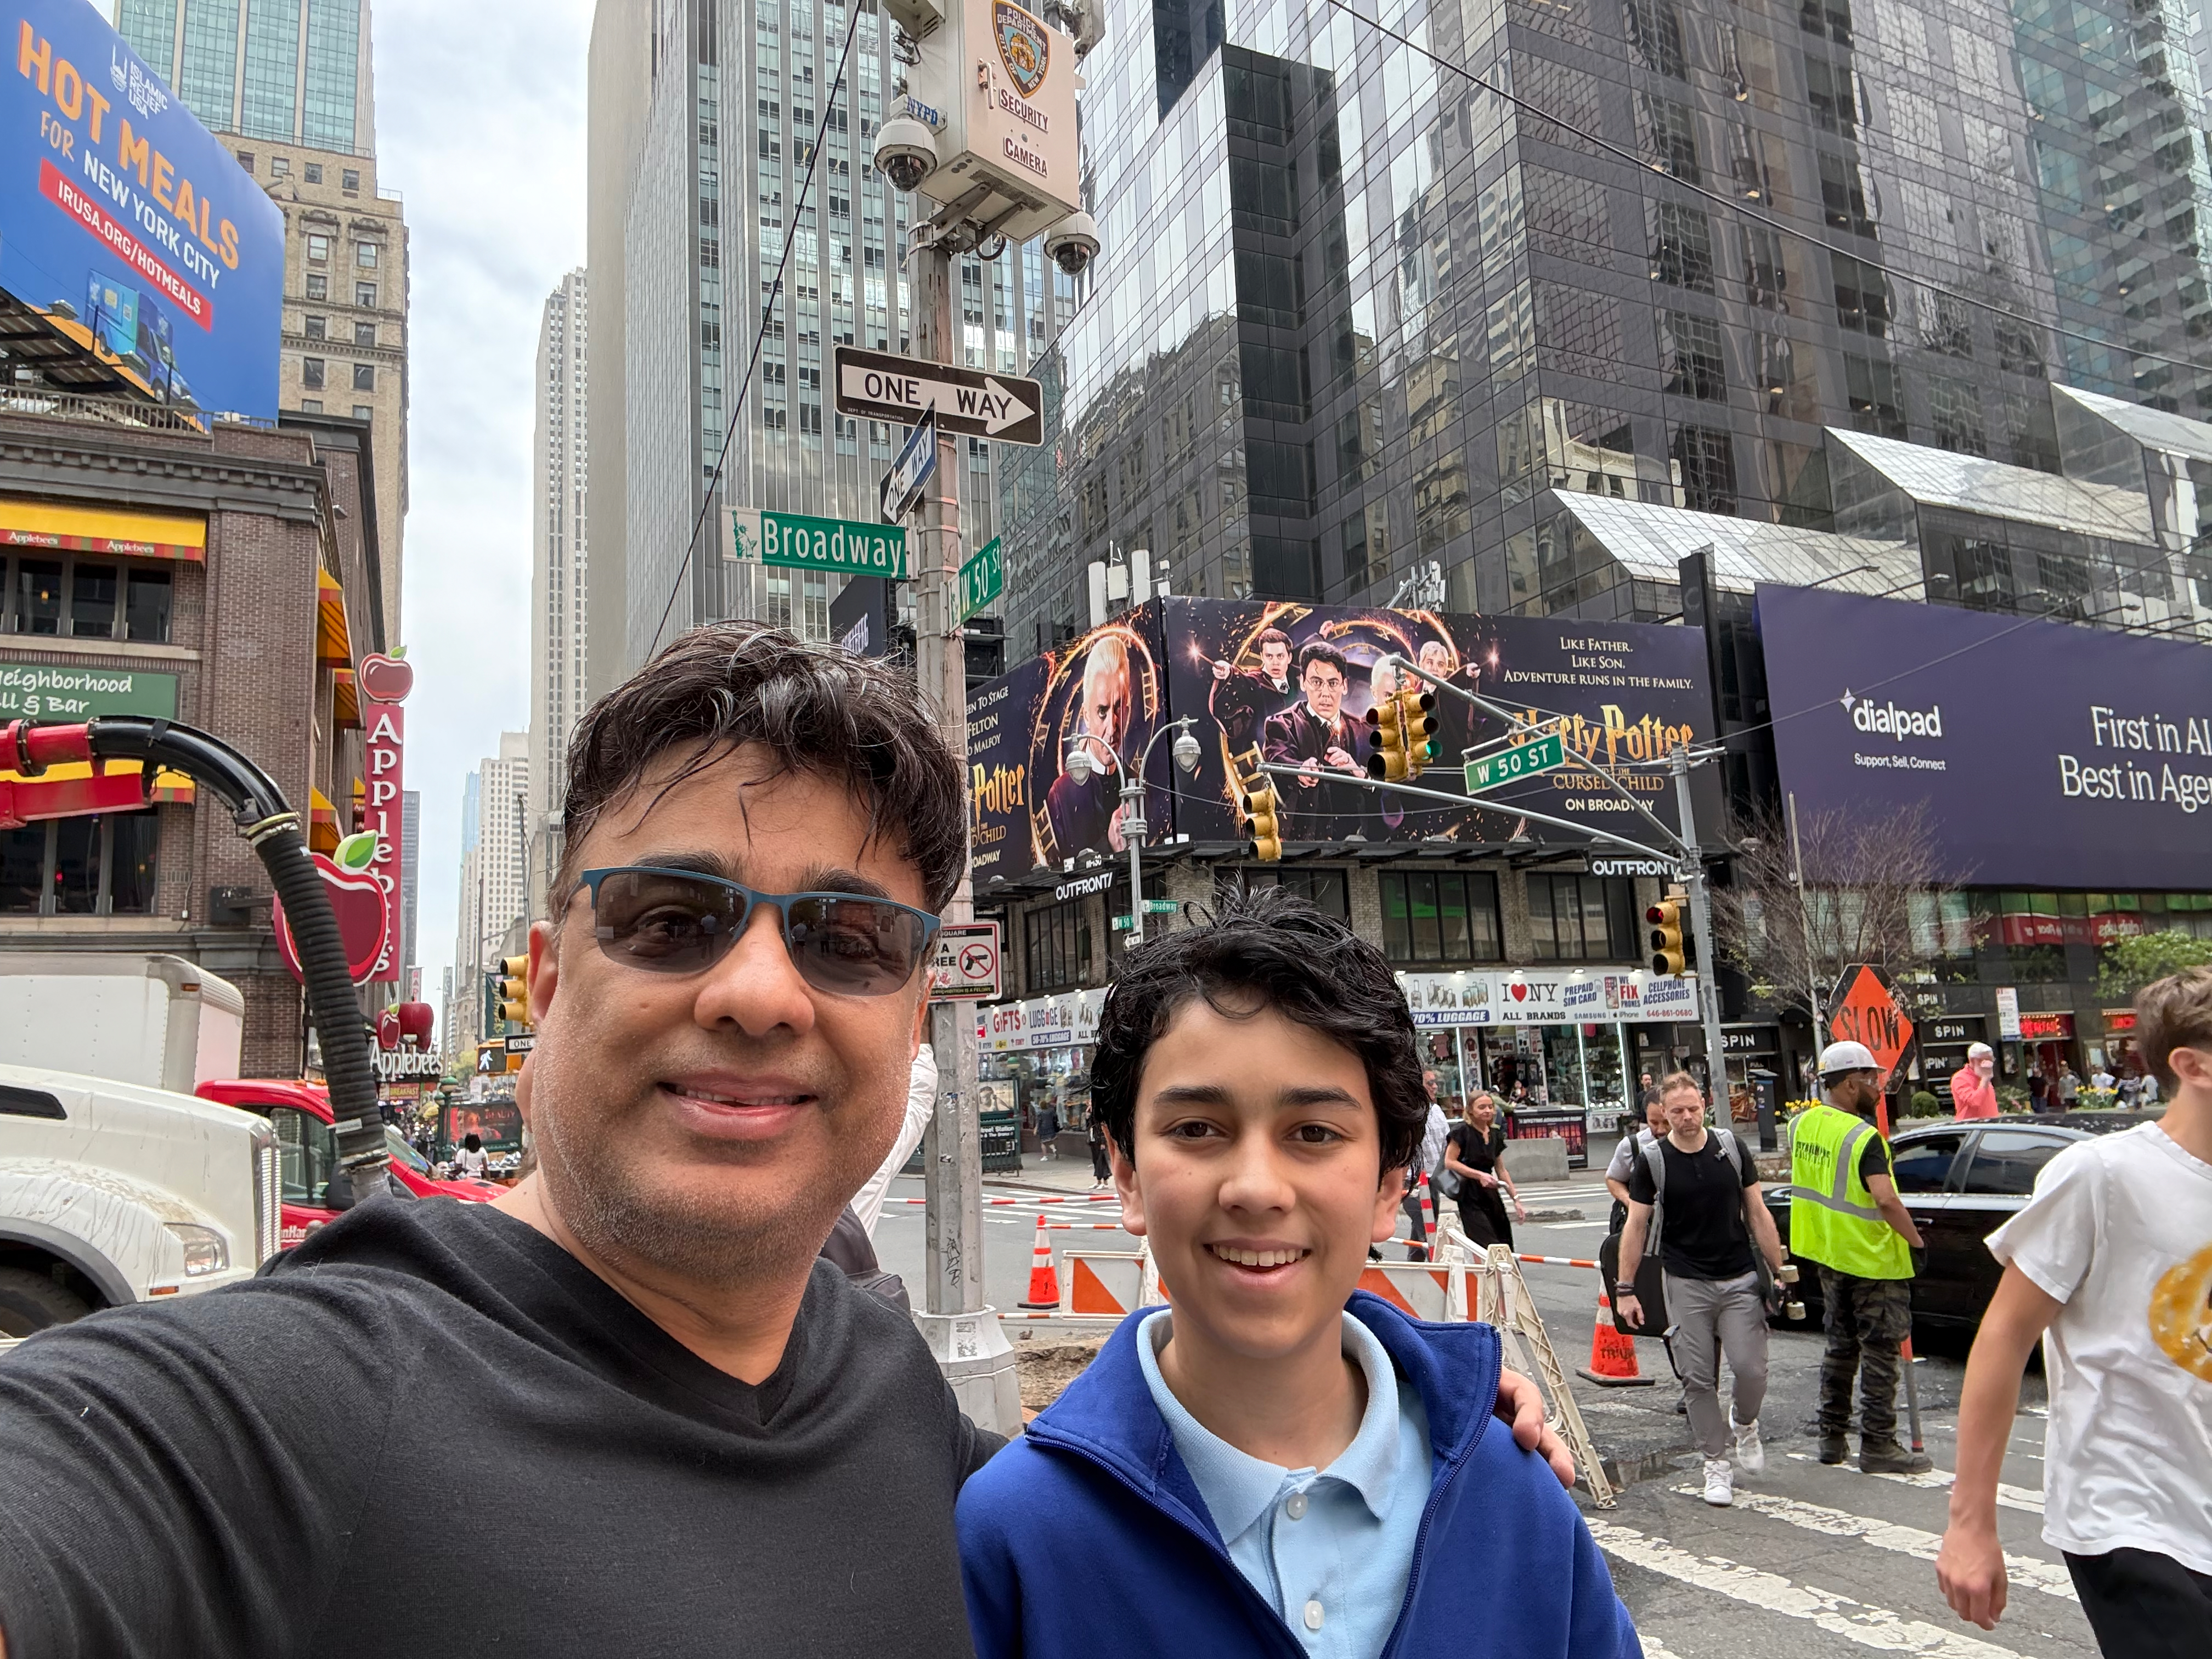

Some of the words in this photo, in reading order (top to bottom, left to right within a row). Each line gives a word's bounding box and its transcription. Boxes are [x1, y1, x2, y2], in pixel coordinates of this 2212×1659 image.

[997, 14, 1046, 51] DEPARTMENT
[1007, 7, 1036, 33] POLICE
[999, 33, 1009, 58] CITY
[1009, 63, 1018, 76] OF
[1028, 76, 1040, 89] NEW
[1038, 55, 1047, 75] YORK
[129, 80, 161, 114] RELIEF
[130, 61, 168, 110] ISLAMIC
[128, 90, 148, 120] USA
[907, 95, 938, 125] NYPD
[1001, 89, 1048, 131] SECURITY
[18, 19, 110, 144] HOT
[118, 119, 239, 270] MEALS
[41, 110, 74, 162] FOR
[1005, 138, 1047, 176] CAMERA
[84, 149, 129, 208] NEW
[133, 193, 180, 257] YORK
[183, 241, 219, 289] CITY
[58, 179, 201, 315] IRUSA.ORG/HOTMEALS
[865, 373, 921, 405] ONE
[956, 388, 1013, 420] WAY
[888, 469, 905, 512] ONE
[912, 435, 929, 479] WAY
[764, 518, 901, 578] Broadway
[960, 573, 970, 614] W
[975, 556, 988, 603] 50
[992, 544, 1001, 574] St
[0, 668, 132, 693] eighborhood
[1612, 676, 1625, 686] IN
[1628, 676, 1650, 687] THE
[22, 695, 40, 715] &
[46, 696, 90, 714] Bar
[1854, 699, 1942, 741] dialpad
[2090, 705, 2152, 750] First
[2154, 713, 2181, 753] in
[1477, 764, 1490, 784] W
[1499, 756, 1522, 777] 50
[1529, 743, 1549, 766] ST
[1854, 753, 1892, 768] Support,
[1910, 757, 1946, 770] Connect
[1617, 776, 1664, 791] CHILD
[2058, 754, 2126, 799] Best
[2128, 760, 2155, 801] in
[973, 762, 1025, 822] Potter
[1565, 798, 1585, 811] ON
[980, 825, 1007, 845] CHILD
[972, 849, 1001, 868] OADWAY
[1149, 901, 1177, 912] Broadway
[1119, 918, 1122, 928] W
[1124, 917, 1130, 927] 50
[1502, 983, 1510, 1002] I
[1528, 983, 1558, 1002] NY
[1565, 982, 1594, 996] PREPAID
[1619, 976, 1629, 984] WE
[1621, 985, 1639, 1000] FIX
[1648, 979, 1685, 994] CELLPHONE
[1564, 995, 1577, 1007] SIM
[1578, 992, 1597, 1003] CARD
[1643, 989, 1690, 1005] ACCESSORIES
[1917, 993, 1938, 1006] SPIN
[994, 1009, 1021, 1033] GIFTS
[1437, 1012, 1486, 1022] LUGGAGE
[1503, 1012, 1522, 1020] ALL
[1527, 1012, 1566, 1020] BRANDS
[1646, 1009, 1692, 1018] 646-861-0680
[1839, 1006, 1900, 1050] SLOW
[1934, 1025, 1965, 1038] SPIN
[514, 1040, 532, 1048] ONE
[1722, 1034, 1755, 1048] SPIN
